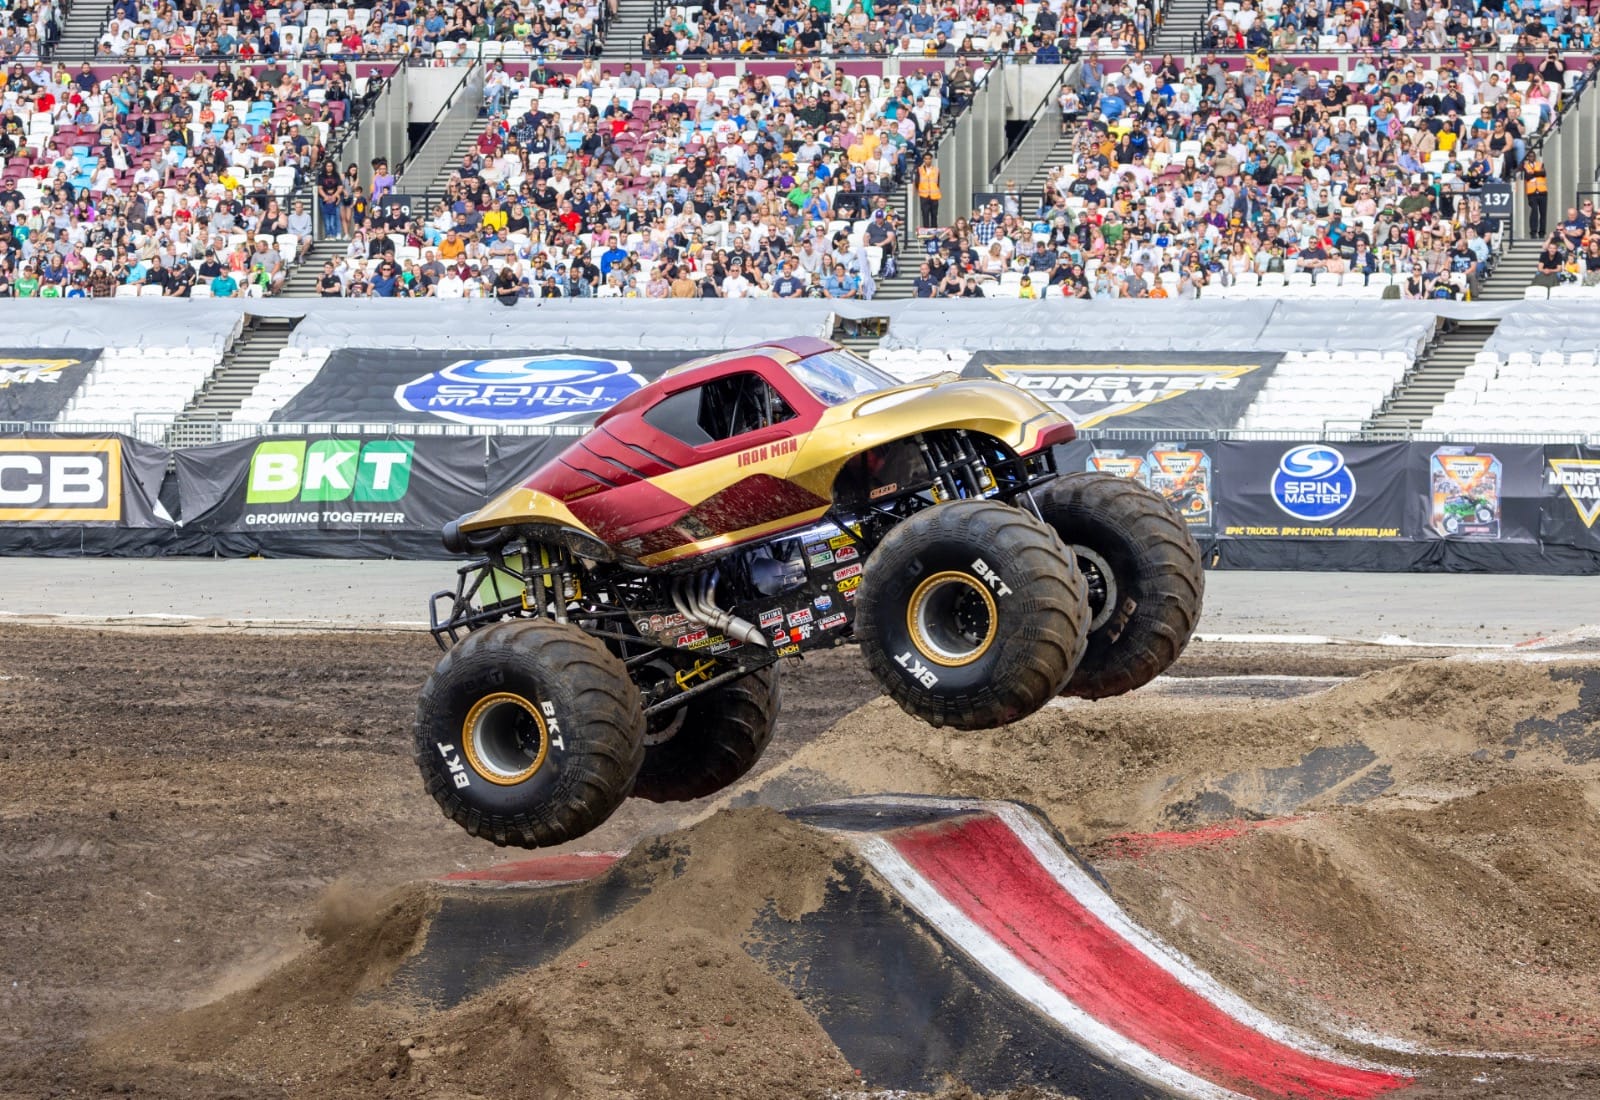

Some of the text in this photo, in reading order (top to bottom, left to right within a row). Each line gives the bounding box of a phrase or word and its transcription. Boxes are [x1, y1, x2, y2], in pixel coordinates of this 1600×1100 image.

[1484, 193, 1510, 206] 137
[385, 205, 410, 217] 19
[437, 384, 605, 399] SPIN
[1042, 389, 1157, 402] JAM
[737, 438, 798, 467] IRON MAN
[252, 451, 408, 493] BKT
[1284, 482, 1341, 494] SPIN
[245, 511, 405, 525] GROWING TOGETHER
[1225, 527, 1244, 535] EPIC
[1246, 527, 1279, 536] TRUCKS.
[1281, 527, 1300, 536] EPIC
[1301, 527, 1335, 536] STUNTS.
[1336, 527, 1378, 537] MONSTER
[837, 547, 856, 558] JAZ
[835, 564, 860, 580] SIMPSON
[971, 557, 1014, 598] BKT
[760, 609, 782, 620] OPTIMA
[678, 630, 707, 646] ARP
[776, 643, 799, 657] UNOH
[894, 651, 939, 689] BKT
[540, 700, 565, 751] BKT
[437, 742, 470, 789] BKT
